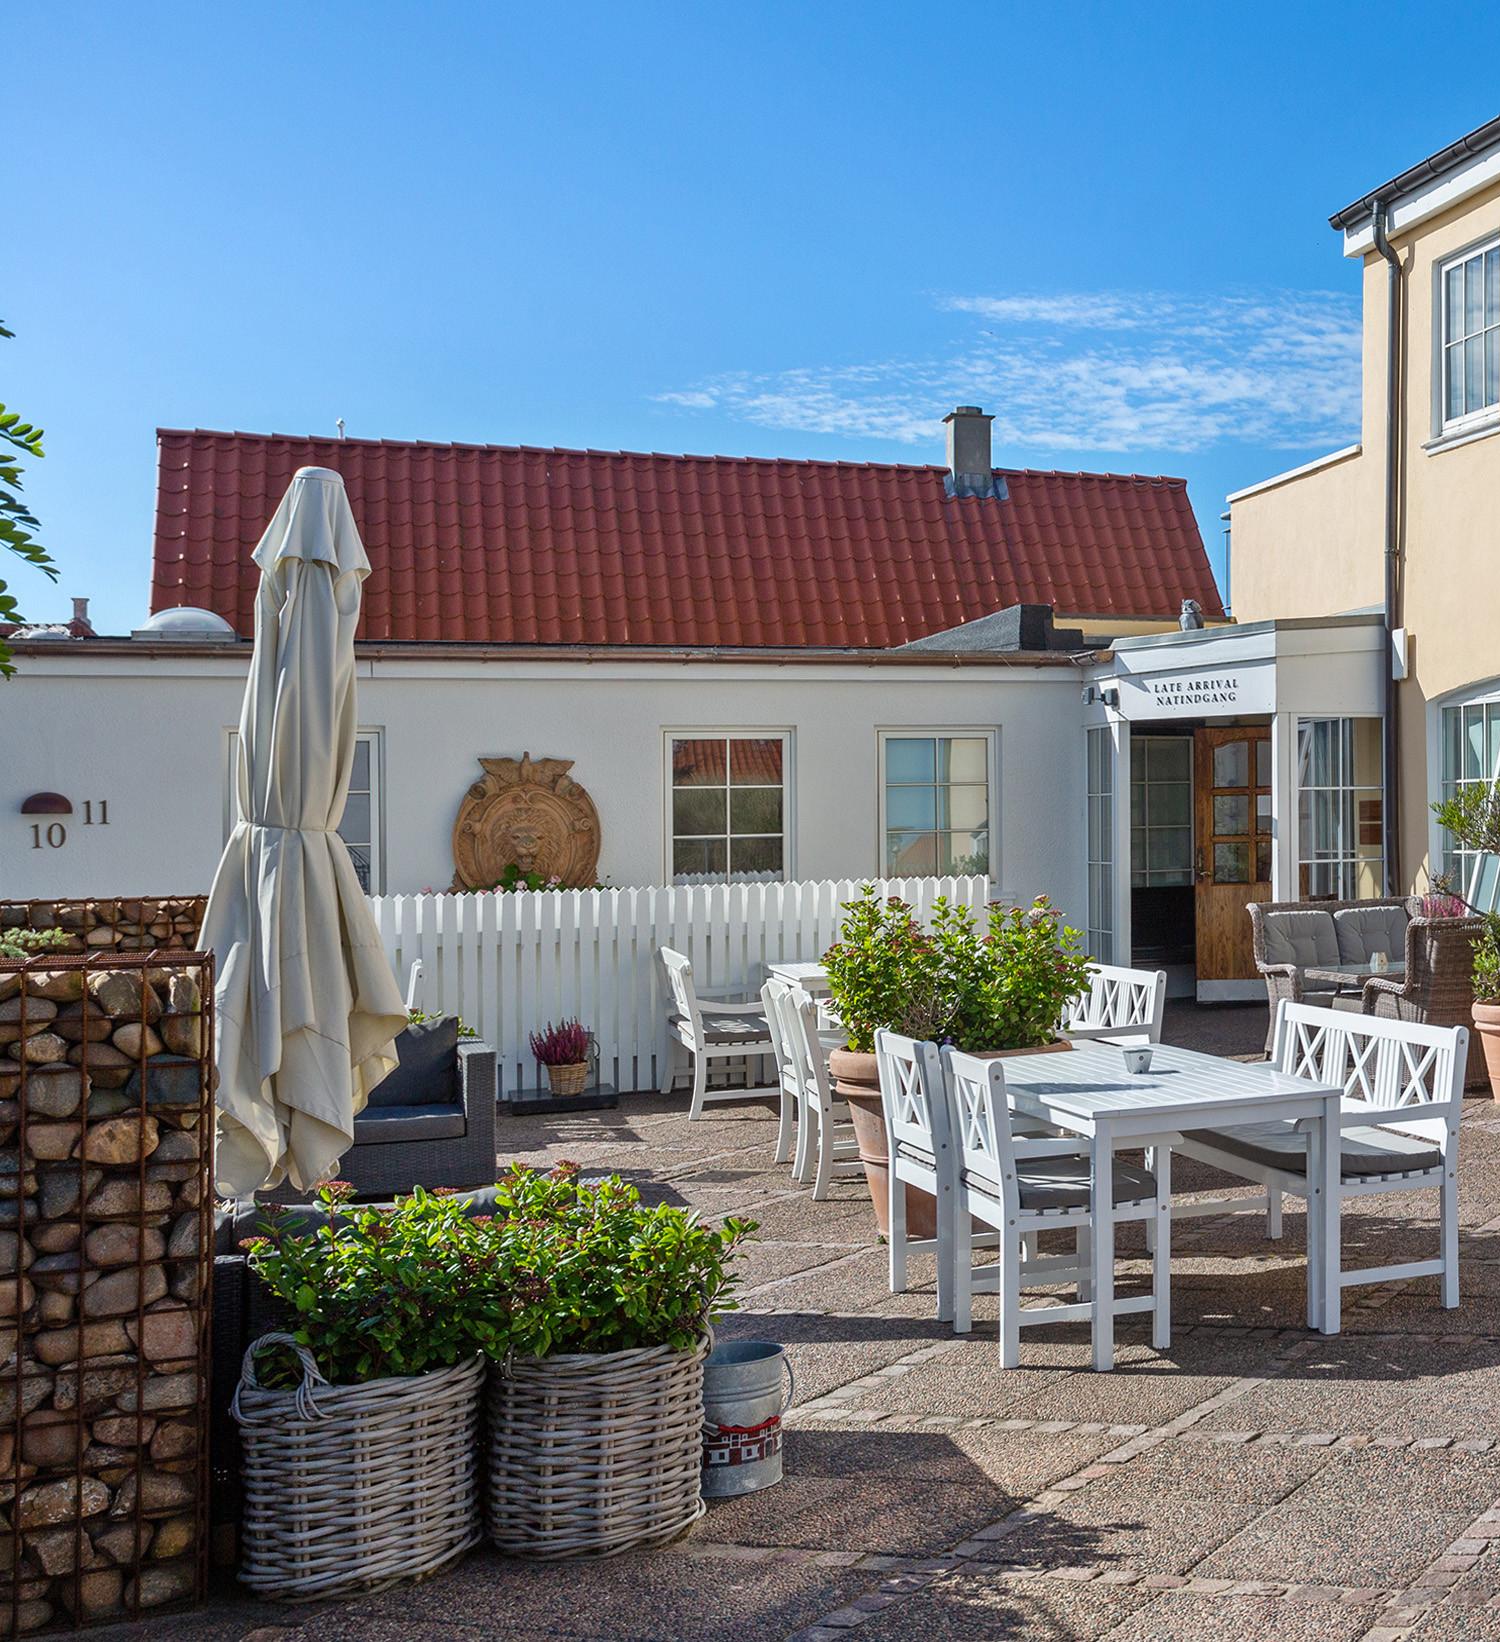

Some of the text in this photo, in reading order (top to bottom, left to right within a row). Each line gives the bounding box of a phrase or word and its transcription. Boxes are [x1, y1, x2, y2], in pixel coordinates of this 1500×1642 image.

[1154, 678, 1239, 694] LATE ARRIVAL
[1156, 691, 1237, 707] NATINDGANG
[82, 799, 111, 825] 11
[30, 822, 67, 849] 10
